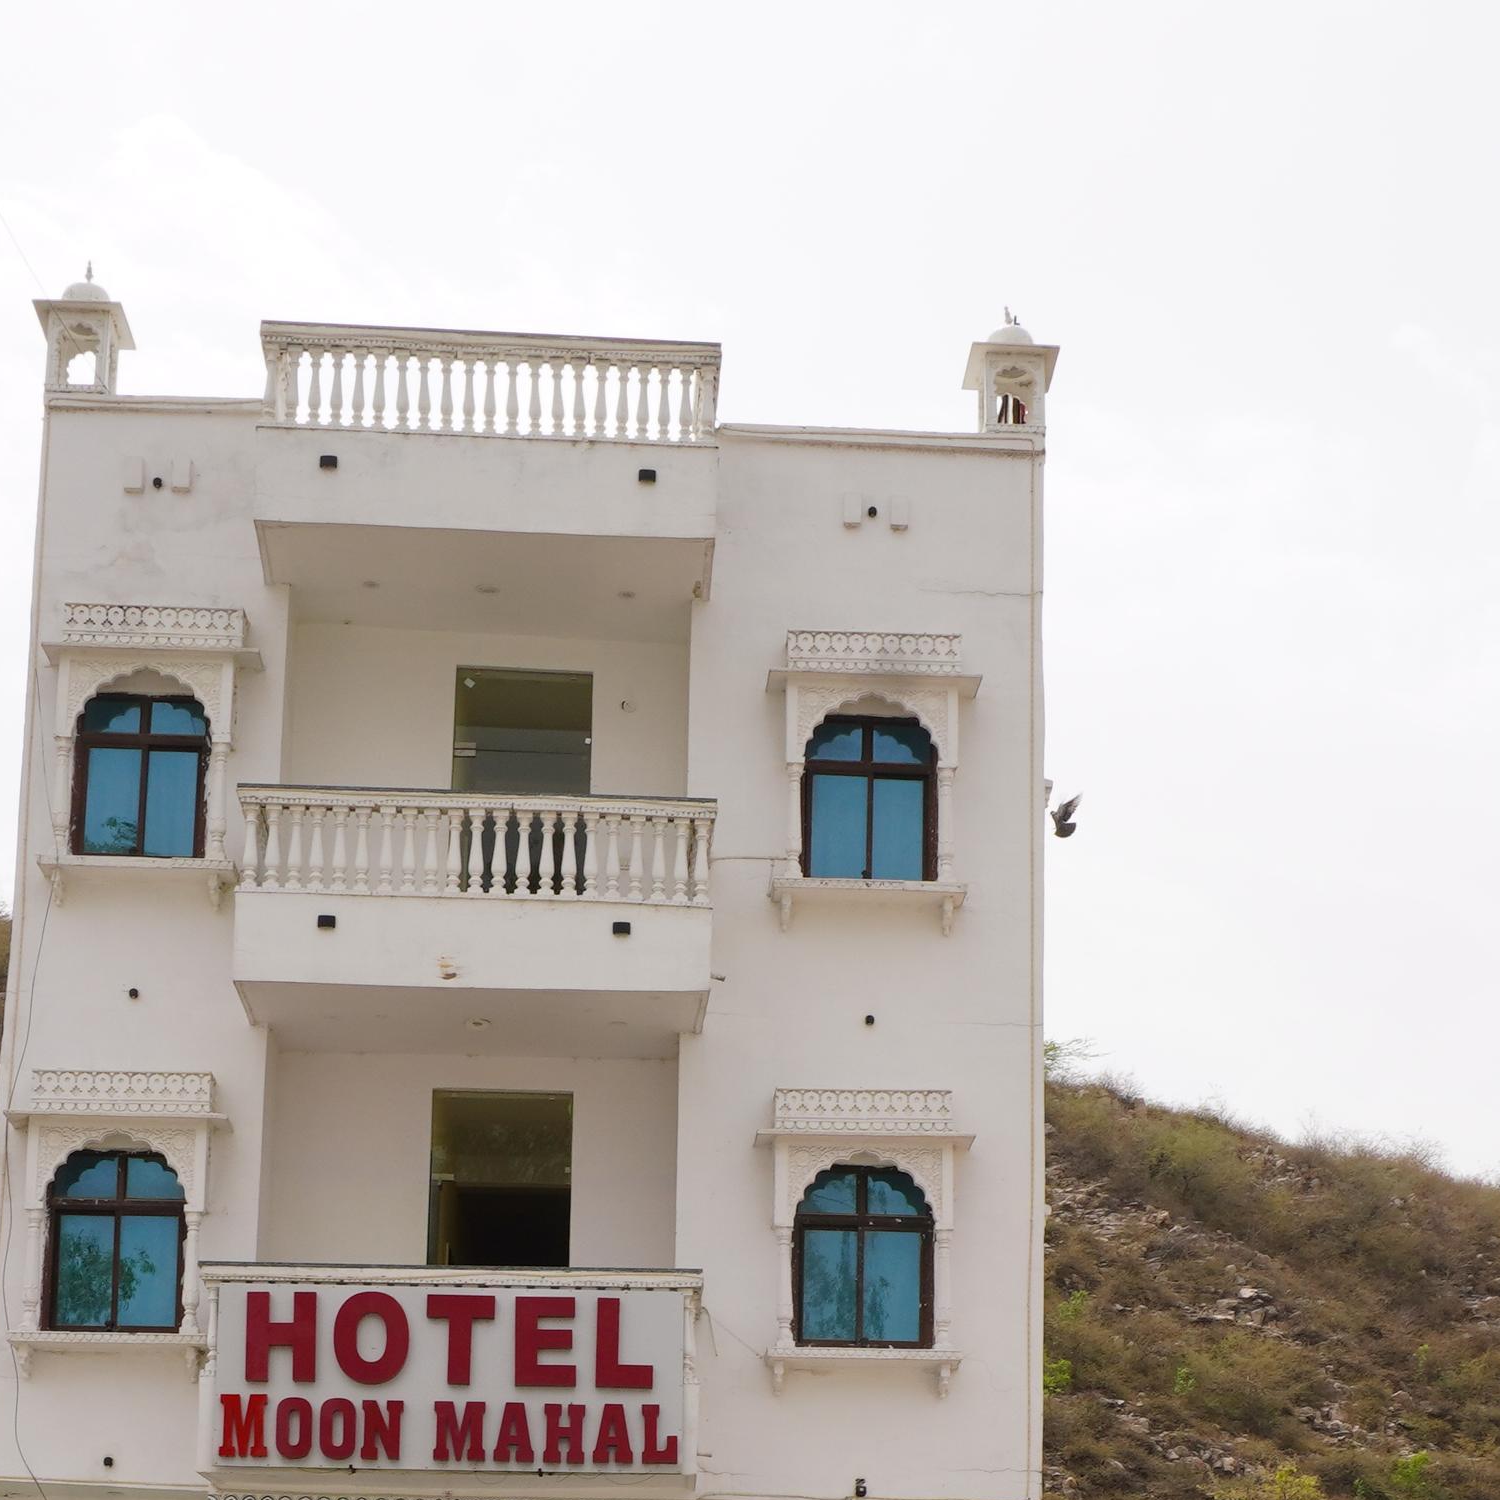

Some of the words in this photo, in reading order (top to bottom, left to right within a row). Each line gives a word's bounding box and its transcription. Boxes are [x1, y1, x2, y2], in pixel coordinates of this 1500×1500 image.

[245, 1291, 654, 1390] HOTEL
[219, 1394, 404, 1461] MOON
[432, 1401, 679, 1466] MAHAL
